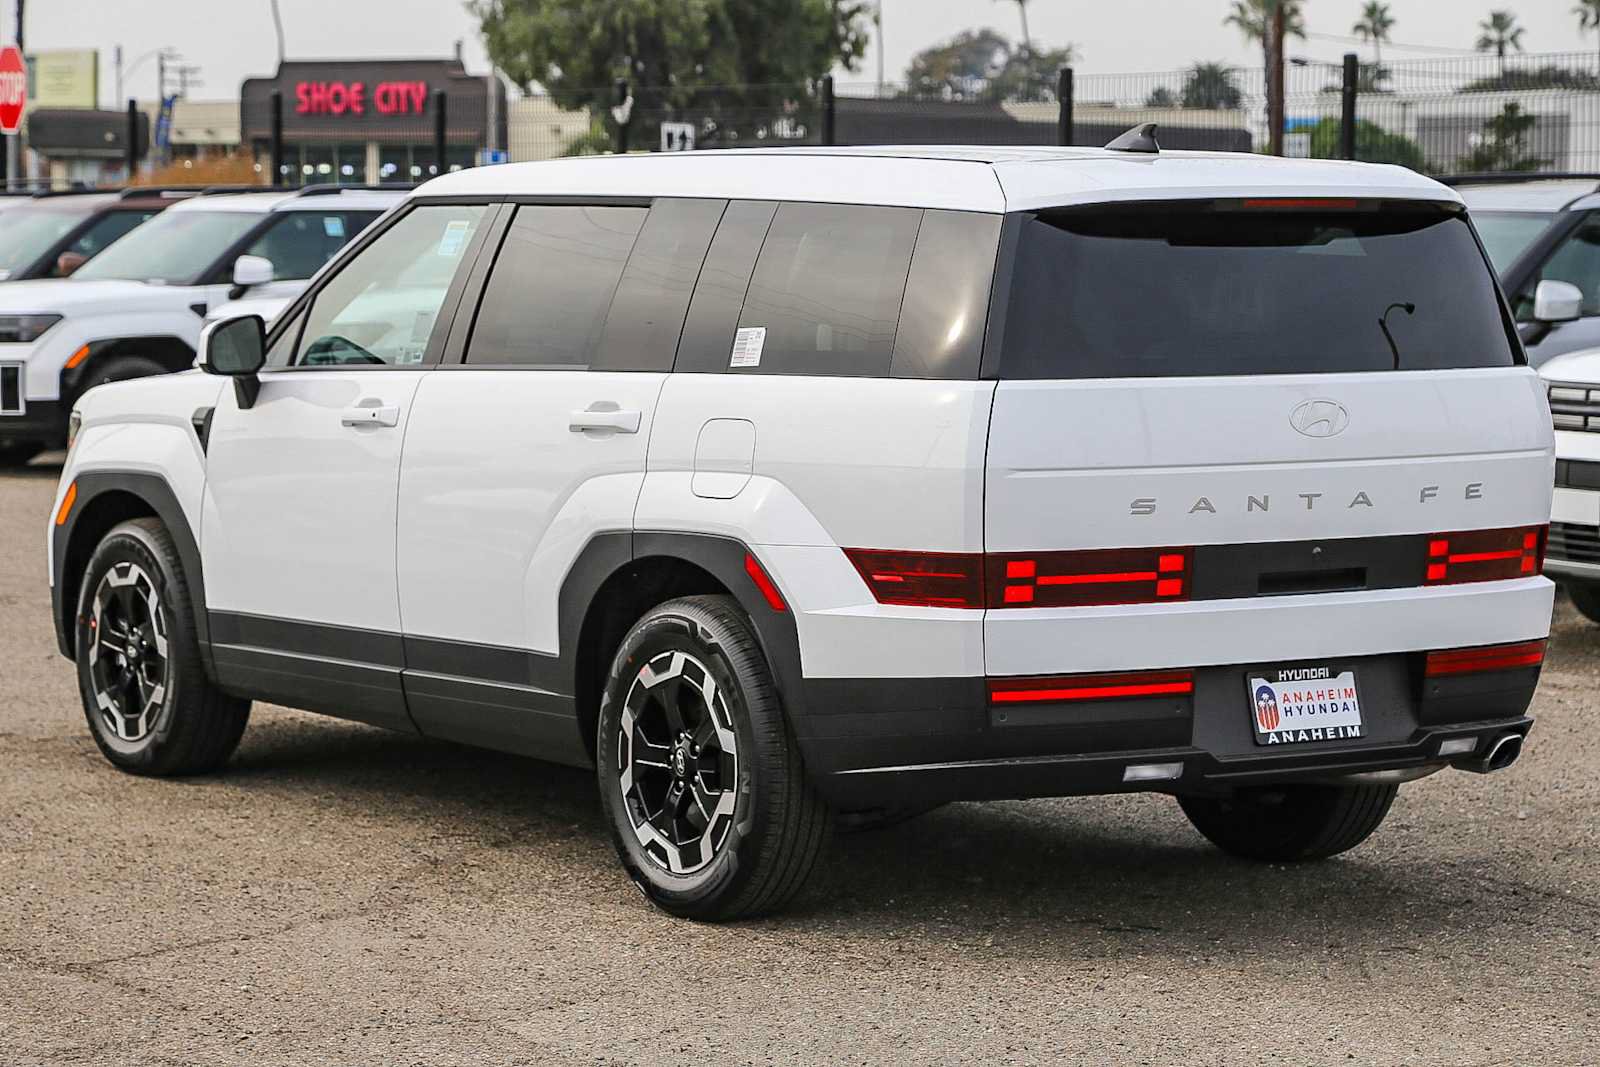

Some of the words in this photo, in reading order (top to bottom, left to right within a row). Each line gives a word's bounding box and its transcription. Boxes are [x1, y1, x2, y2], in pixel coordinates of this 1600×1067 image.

[295, 80, 365, 114] SHOE
[373, 80, 428, 114] CITY
[1129, 490, 1374, 516] SANTA
[1418, 482, 1484, 504] FE
[1278, 667, 1330, 681] HYUNDAI
[1282, 687, 1355, 704] ANAHEIM
[1284, 701, 1357, 717] HYUNDAI
[1268, 725, 1361, 745] ANAHEIM
